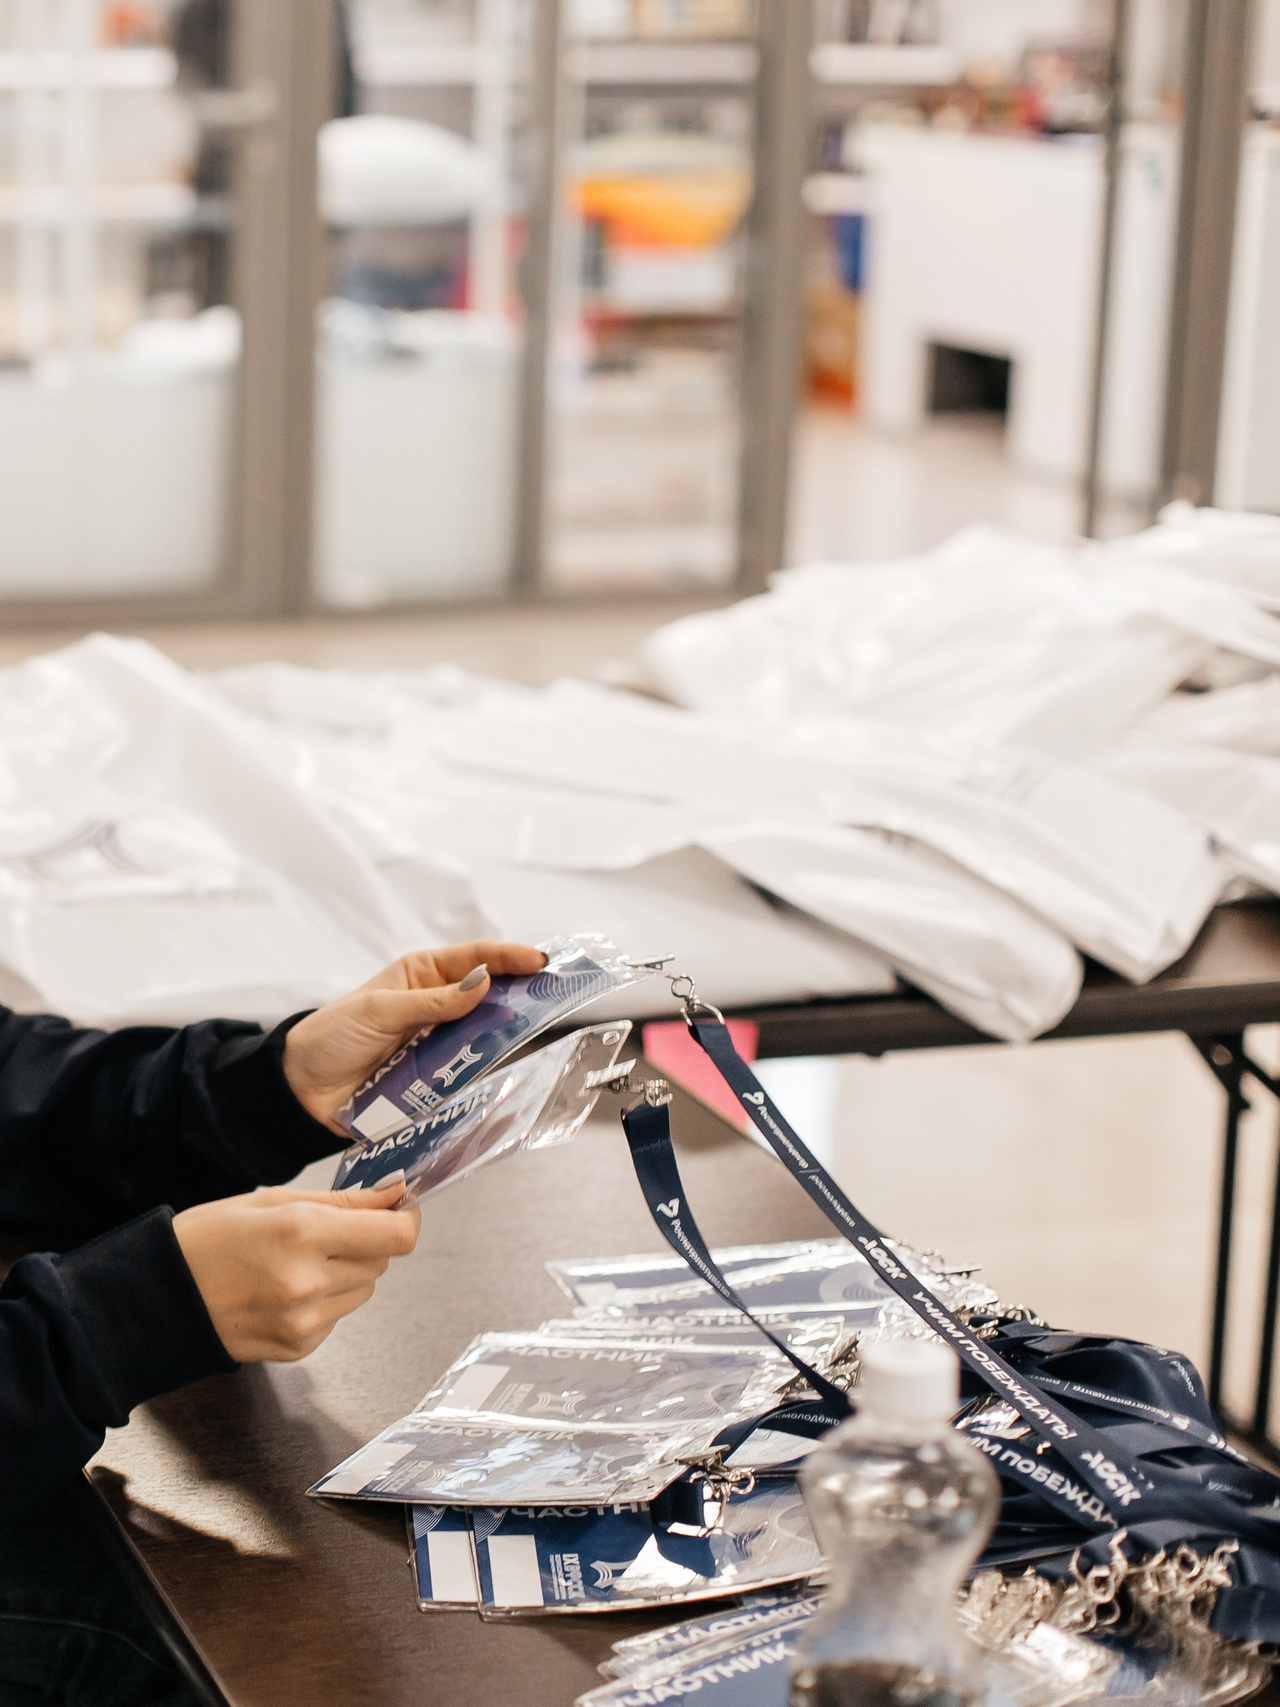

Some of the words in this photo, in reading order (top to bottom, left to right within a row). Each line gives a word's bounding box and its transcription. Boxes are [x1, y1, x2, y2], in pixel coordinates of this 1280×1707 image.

[506, 1345, 667, 1364] ЧАСТНИК
[913, 1291, 960, 1338] УЧИМ
[959, 1335, 1079, 1441] ПОБЕЖДАТЬ!
